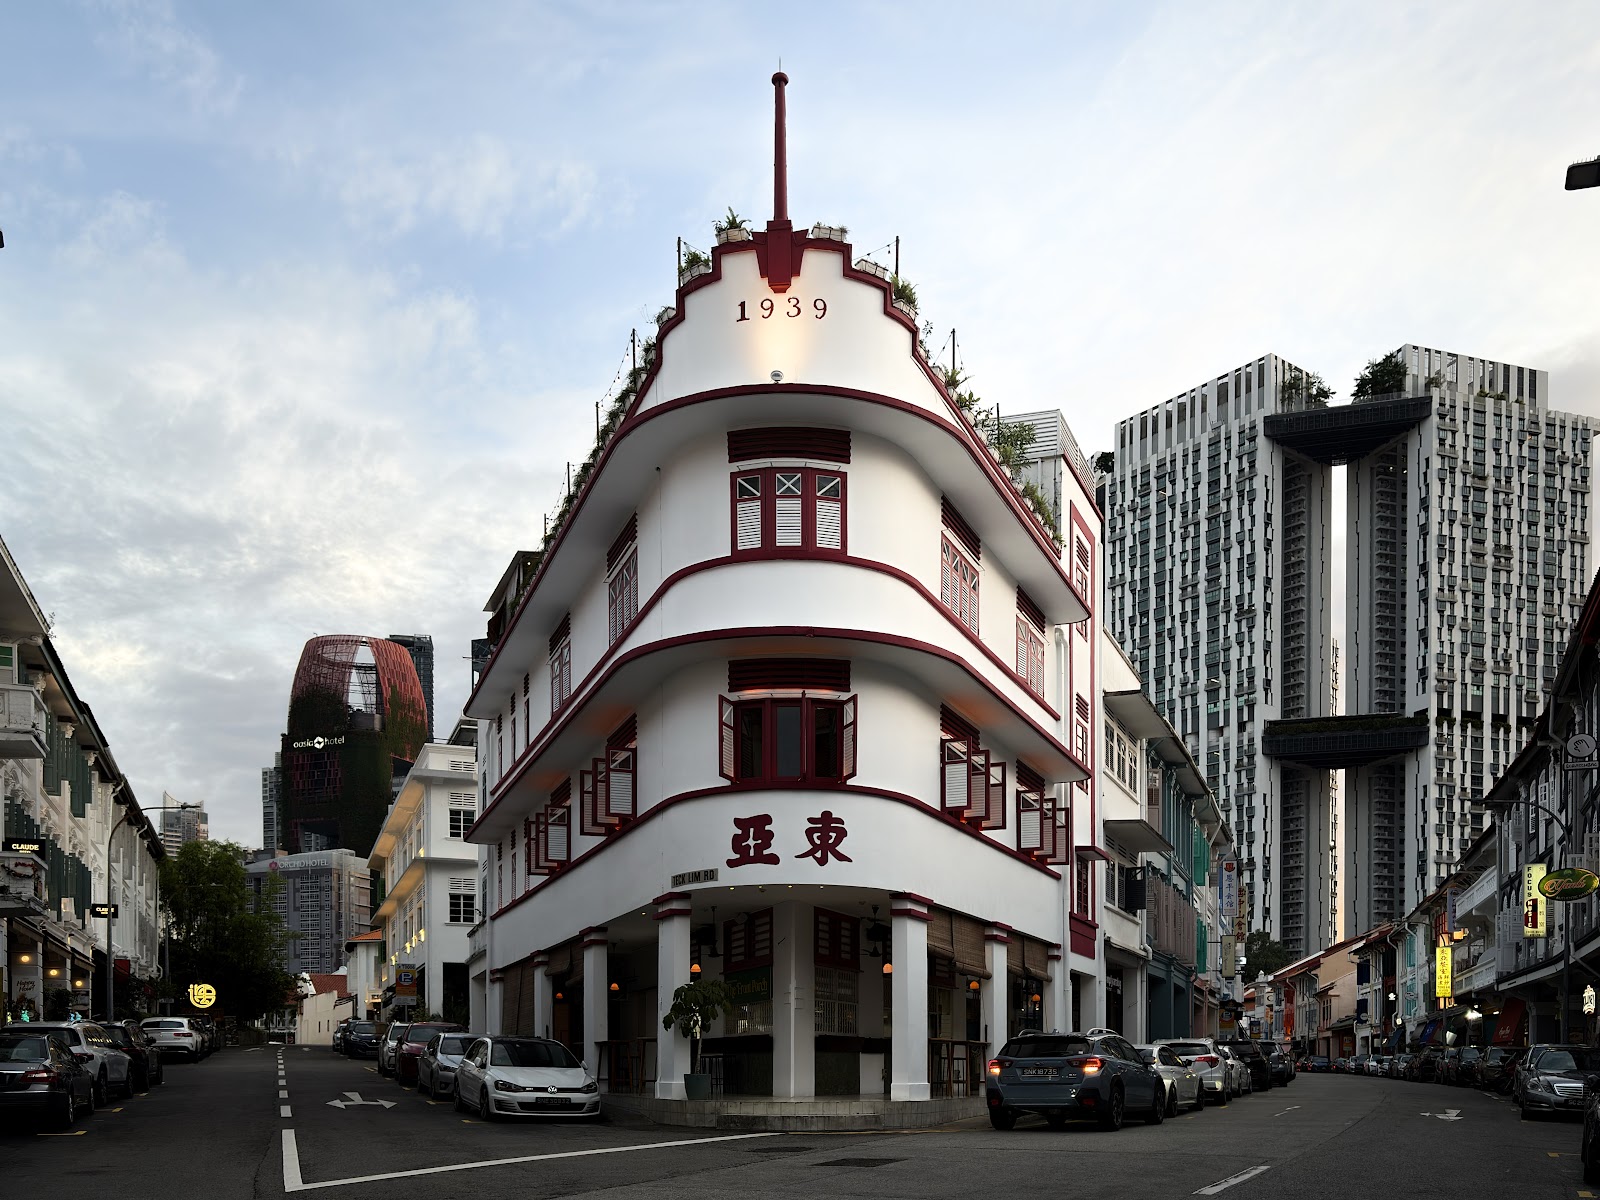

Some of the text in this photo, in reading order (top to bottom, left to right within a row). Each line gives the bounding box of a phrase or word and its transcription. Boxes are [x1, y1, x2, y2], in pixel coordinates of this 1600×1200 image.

[736, 296, 828, 322] 1939
[292, 735, 345, 749] oasia hotel
[278, 859, 329, 869] ORCHID HOTEL
[673, 871, 715, 886] TECK LIM RD
